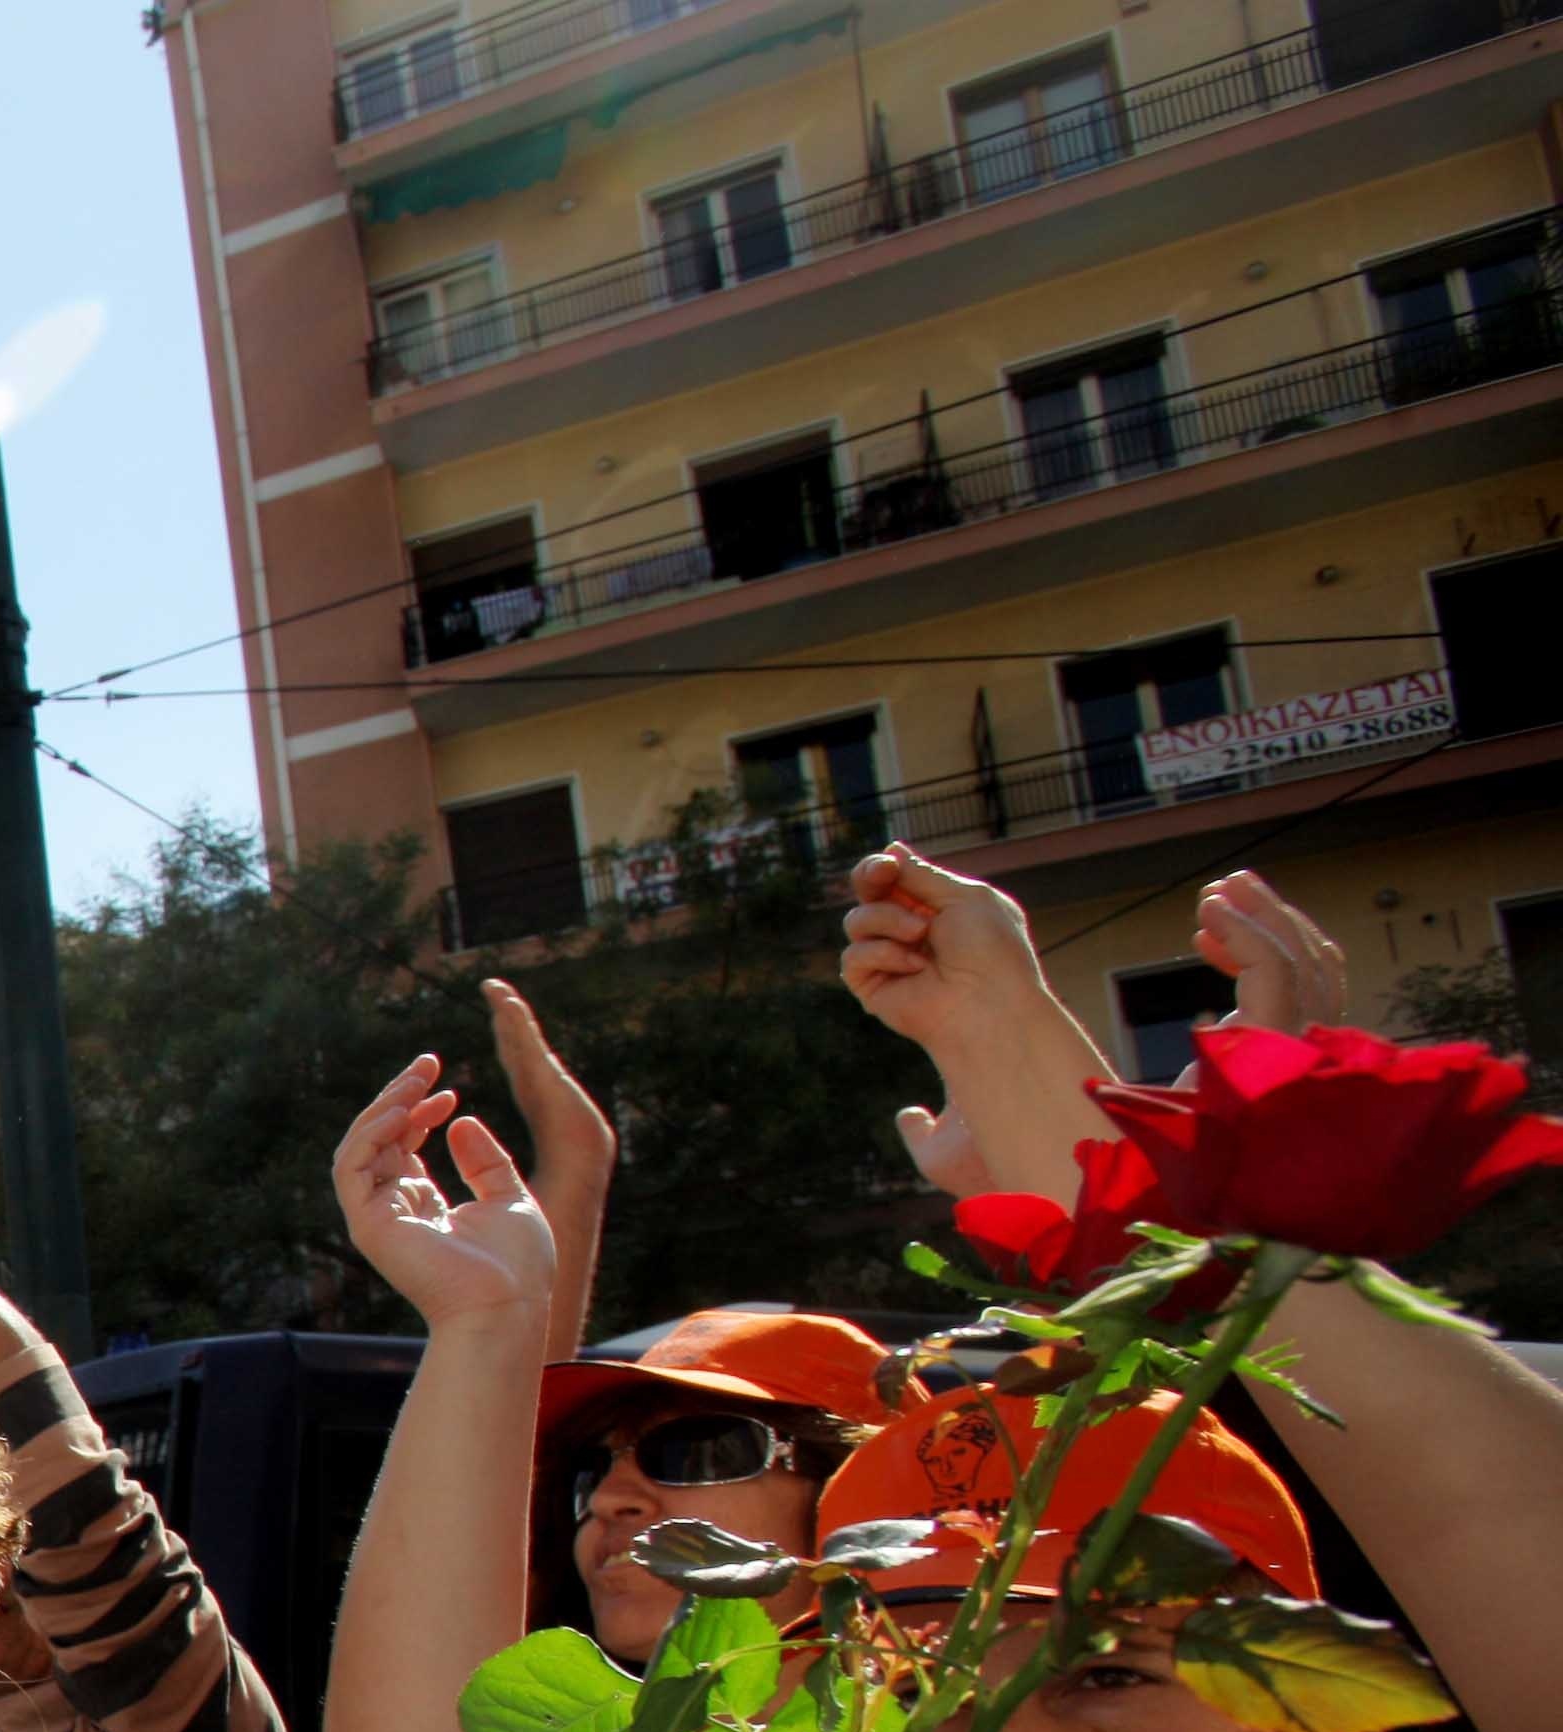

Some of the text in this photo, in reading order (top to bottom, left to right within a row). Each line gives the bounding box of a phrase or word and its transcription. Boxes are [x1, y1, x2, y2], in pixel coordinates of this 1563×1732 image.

[1142, 669, 1445, 759] ΕΝΟΙΚΙΑΖΕΤΑΙ
[1224, 728, 1326, 769] 22610
[1342, 702, 1450, 745] 28688
